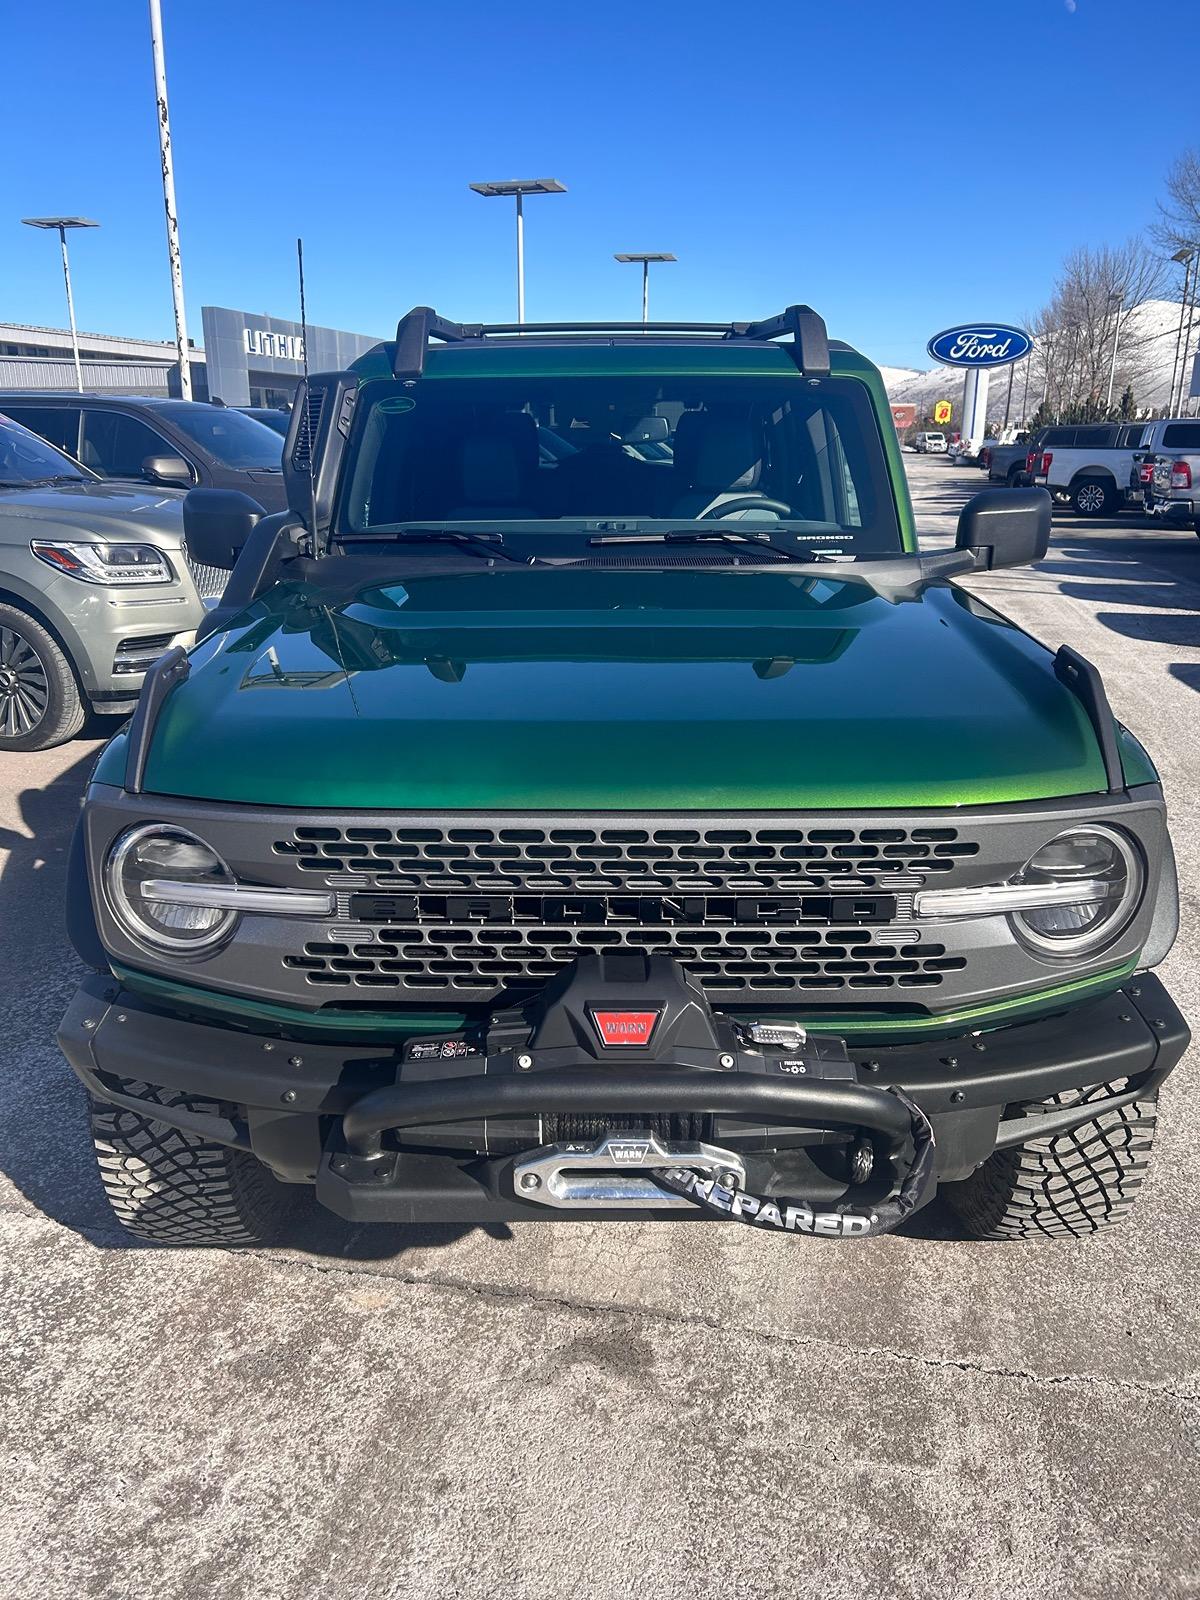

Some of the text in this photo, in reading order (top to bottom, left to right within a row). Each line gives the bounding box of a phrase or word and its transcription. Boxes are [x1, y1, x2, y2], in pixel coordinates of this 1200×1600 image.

[950, 333, 1012, 358] Ford
[605, 1022, 646, 1034] WARN
[614, 1150, 642, 1159] WARN
